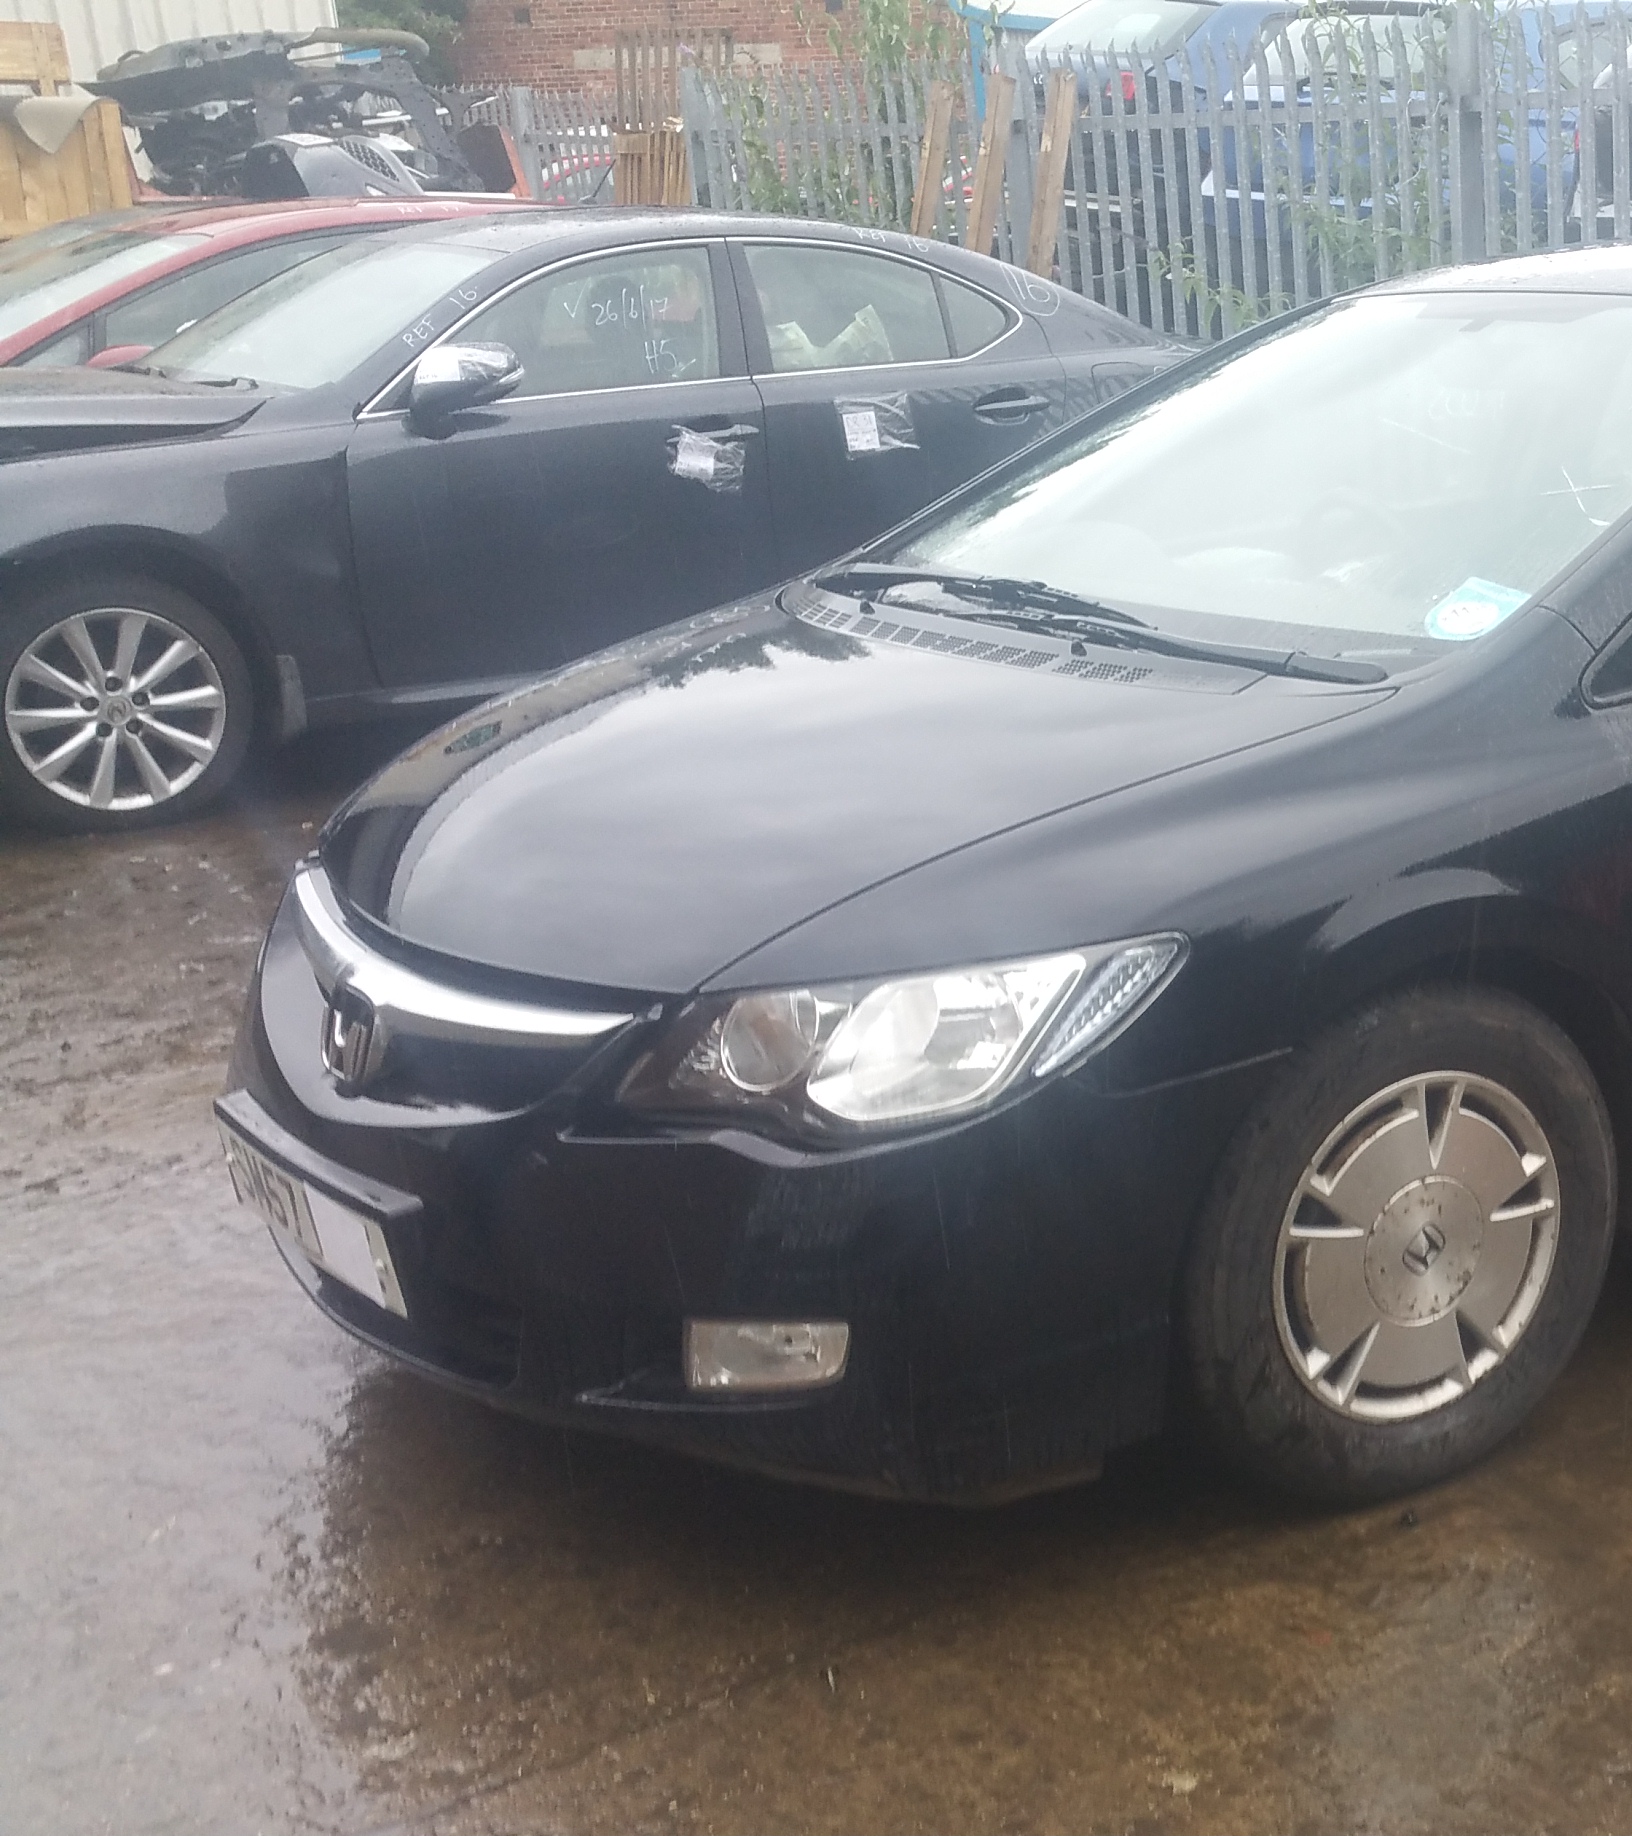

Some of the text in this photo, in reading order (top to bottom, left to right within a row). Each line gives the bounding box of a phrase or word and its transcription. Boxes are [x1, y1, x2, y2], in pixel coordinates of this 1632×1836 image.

[1004, 264, 1051, 303] 16
[591, 284, 669, 330] 26/6/17
[402, 312, 435, 348] REF
